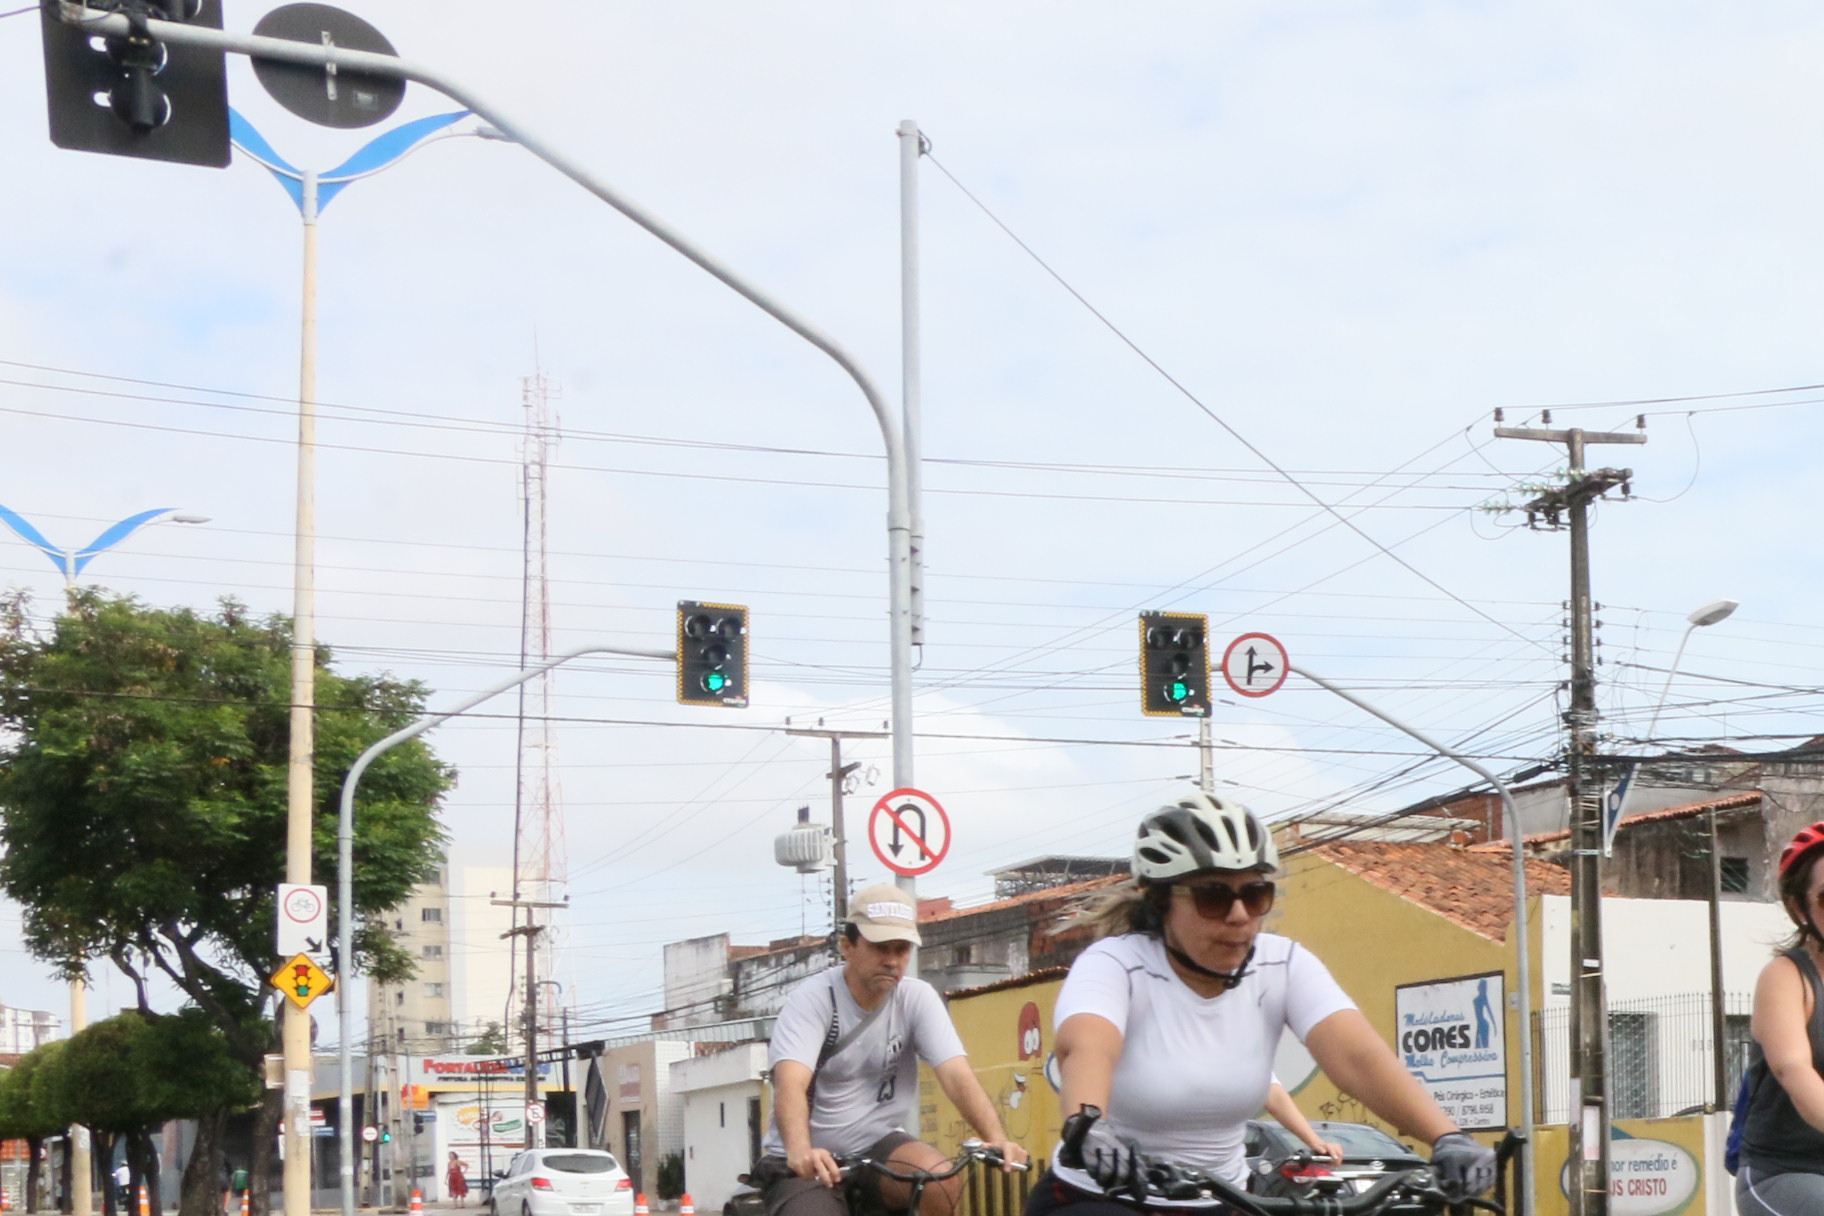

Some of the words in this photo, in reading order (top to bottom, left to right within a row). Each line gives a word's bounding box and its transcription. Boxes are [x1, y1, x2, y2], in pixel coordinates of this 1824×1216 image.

[1402, 1023, 1471, 1054] CORES
[1628, 1153, 1669, 1172] remédio
[1627, 1178, 1667, 1196] CRISTO
